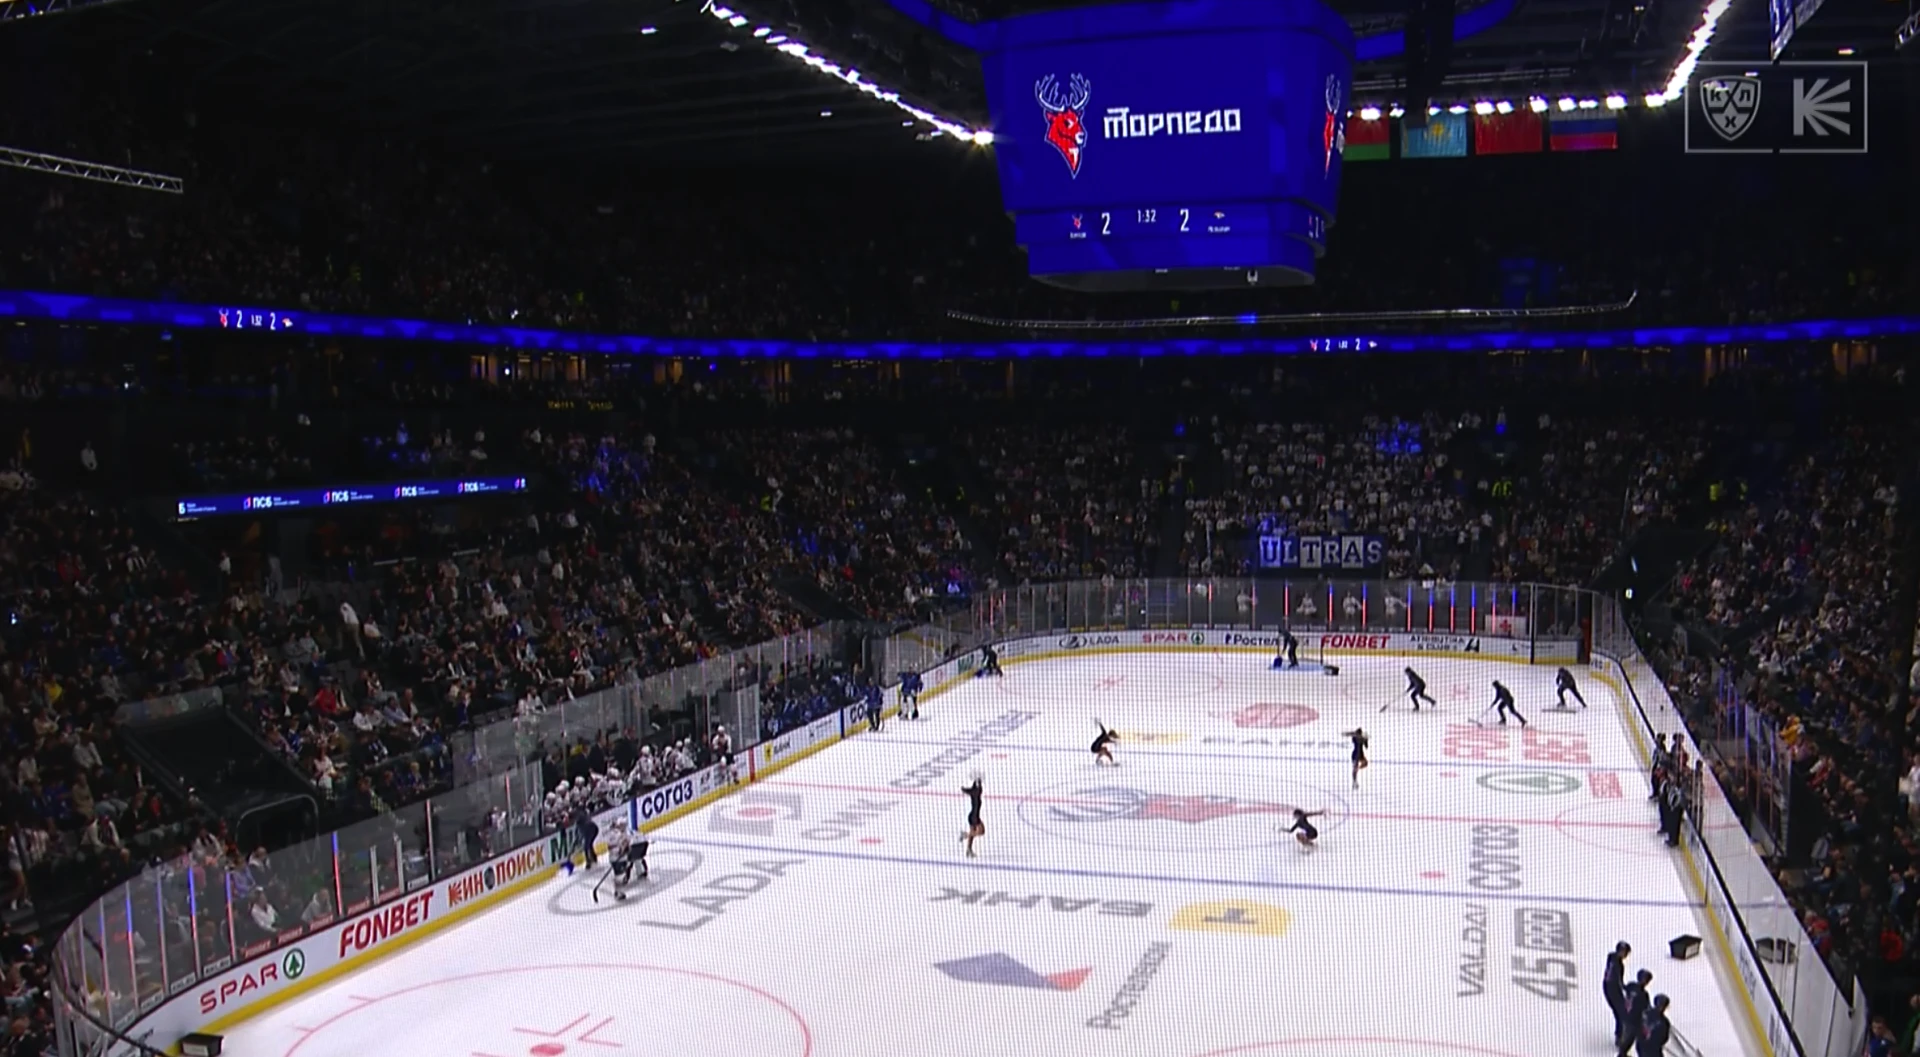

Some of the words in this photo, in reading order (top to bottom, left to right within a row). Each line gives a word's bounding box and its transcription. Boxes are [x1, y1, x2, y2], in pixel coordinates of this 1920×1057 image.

[1102, 212, 1111, 235] 2
[1137, 209, 1157, 223] 1:32
[1180, 208, 1190, 232] 2
[237, 309, 243, 328] 2
[270, 312, 276, 331] 2
[1325, 338, 1331, 352] 2
[1355, 337, 1361, 351] 2
[1260, 536, 1382, 567] ULTRAS
[1089, 634, 1119, 646] LADA
[1142, 632, 1187, 644] SPAR
[1320, 634, 1391, 649] FONBET
[641, 779, 693, 819] согаз
[1468, 824, 1522, 891] согаз
[639, 858, 806, 932] LADA
[339, 889, 434, 959] FONBET
[200, 962, 279, 1015] SPAR
